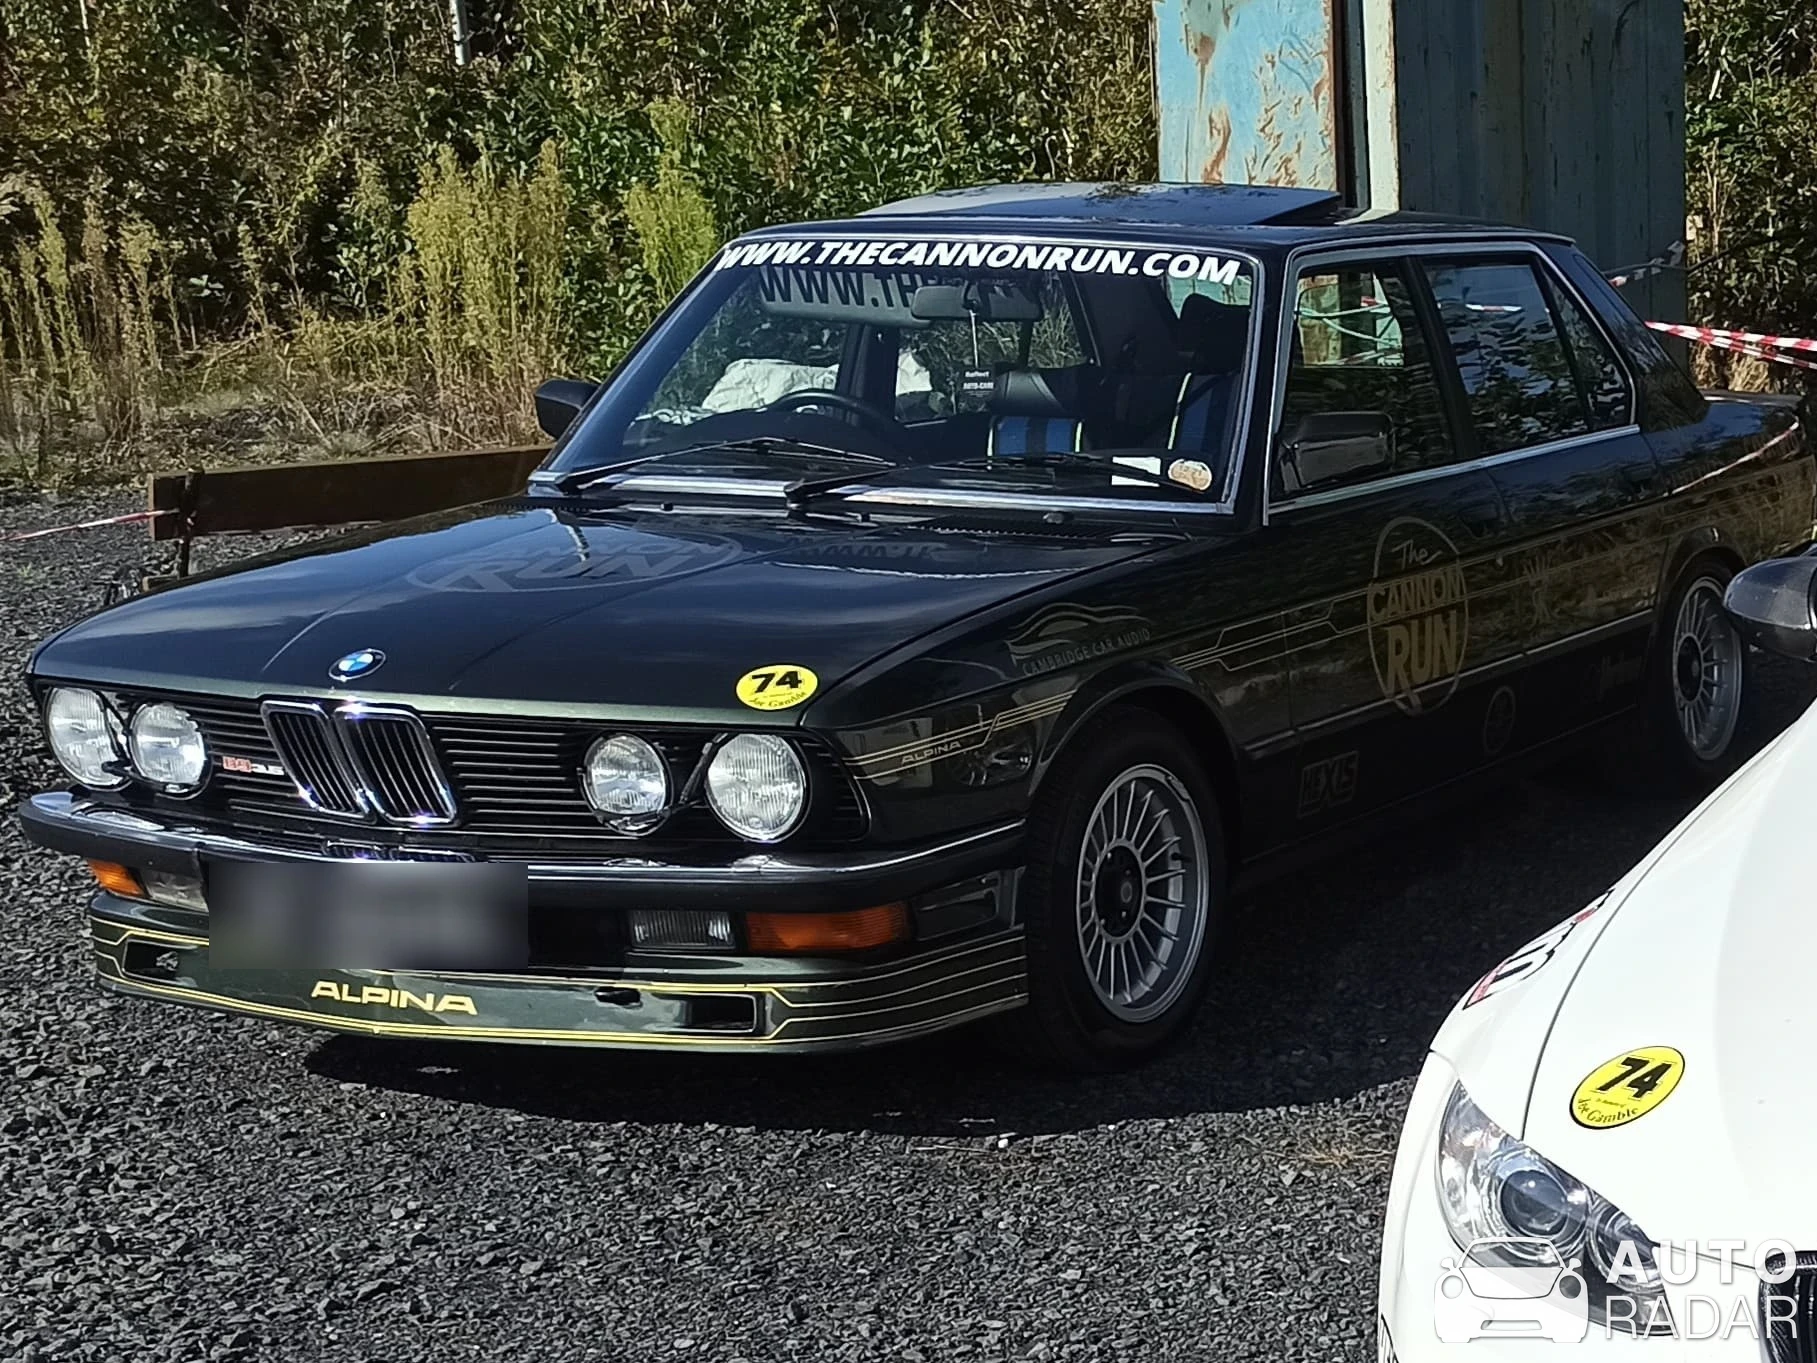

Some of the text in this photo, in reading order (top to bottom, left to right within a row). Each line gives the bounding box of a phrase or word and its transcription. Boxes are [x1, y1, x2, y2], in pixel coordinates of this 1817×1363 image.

[715, 240, 1240, 286] WWW.THECANNONRUN.COM
[1392, 539, 1442, 570] The
[1369, 566, 1462, 623] CANNON
[1022, 628, 1151, 676] CAMBRIDGE CAR AUDIO
[1382, 609, 1459, 714] RUN
[752, 670, 803, 694] 74
[901, 741, 962, 766] ALPINA
[311, 980, 478, 1016] ALPINA
[1596, 1057, 1672, 1099] 74
